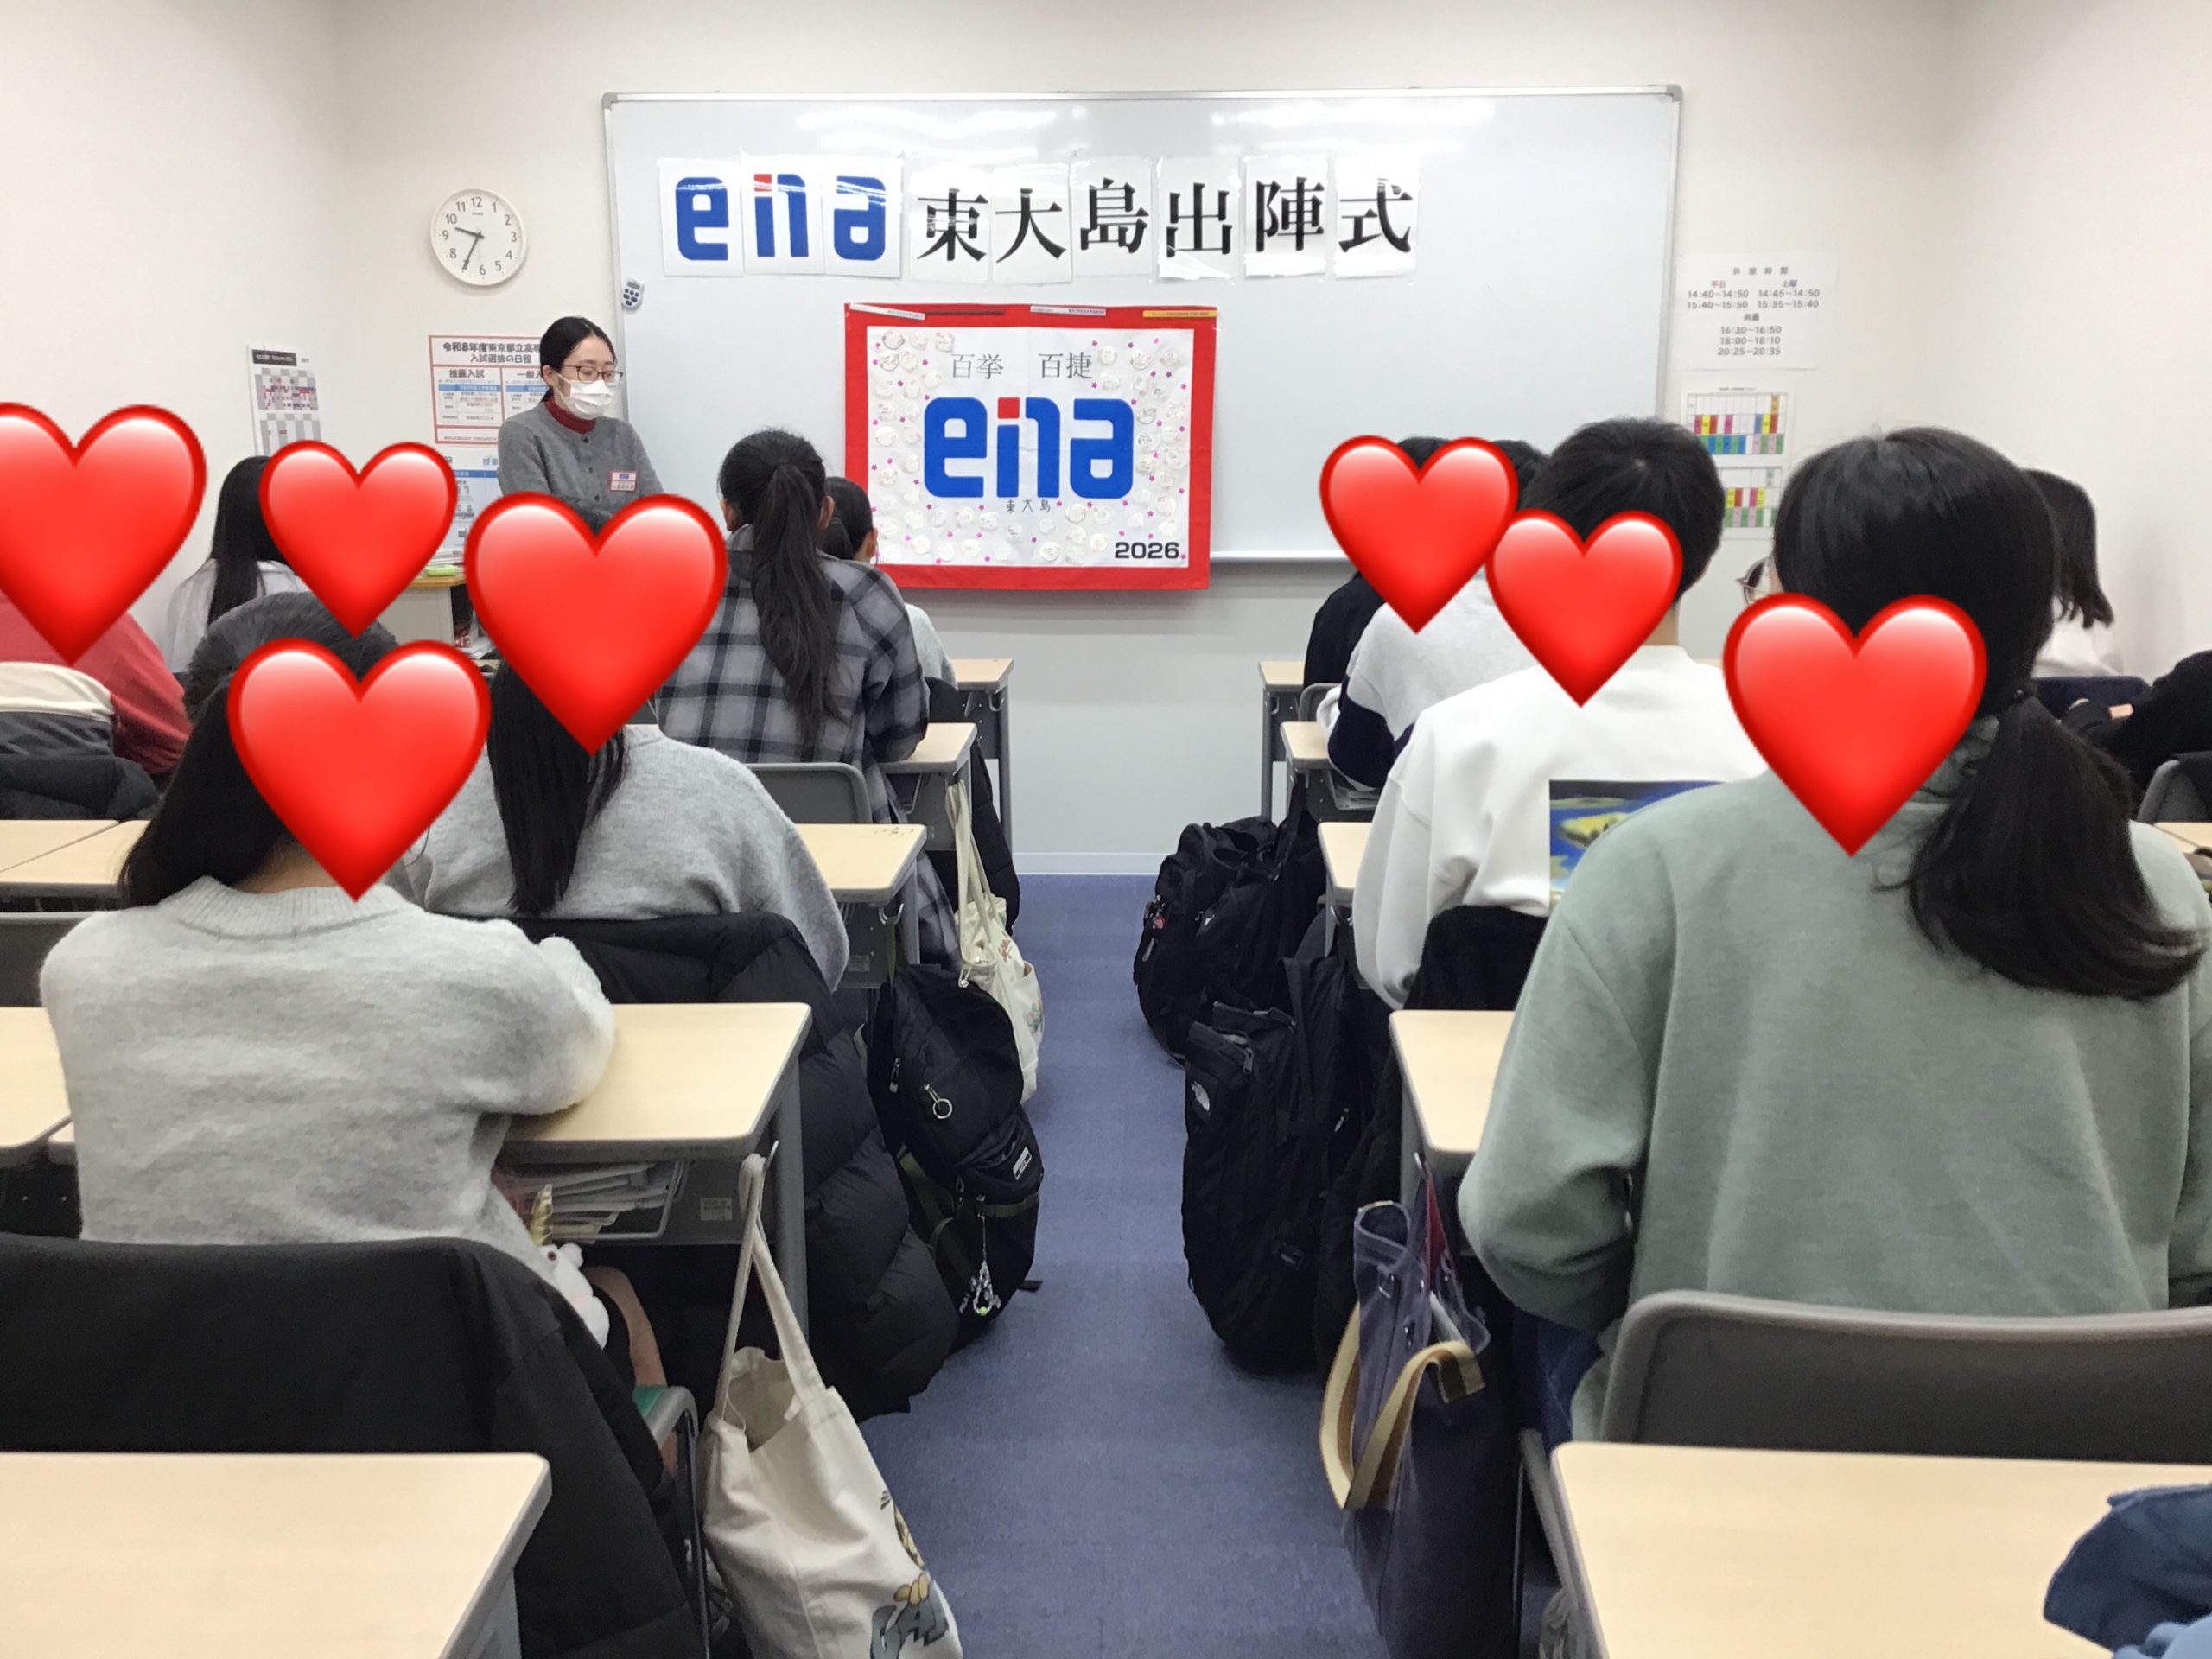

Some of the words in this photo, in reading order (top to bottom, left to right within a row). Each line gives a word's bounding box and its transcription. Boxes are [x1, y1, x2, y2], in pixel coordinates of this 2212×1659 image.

[456, 201, 466, 212] 11
[471, 196, 483, 208] 12
[492, 201, 497, 213] 1
[445, 213, 458, 225] 10
[504, 214, 512, 226] 2
[676, 173, 886, 261] ena
[917, 176, 1413, 263] 東大島出陣式
[442, 230, 449, 241] 9
[511, 231, 518, 243] 3
[449, 247, 457, 259] 8
[505, 249, 513, 260] 4
[479, 264, 486, 276] 6
[494, 260, 502, 271] 5
[950, 353, 1004, 380] 百挙
[924, 396, 1135, 499] ena
[1005, 499, 1052, 514] 東大島
[1114, 541, 1180, 560] 2026
